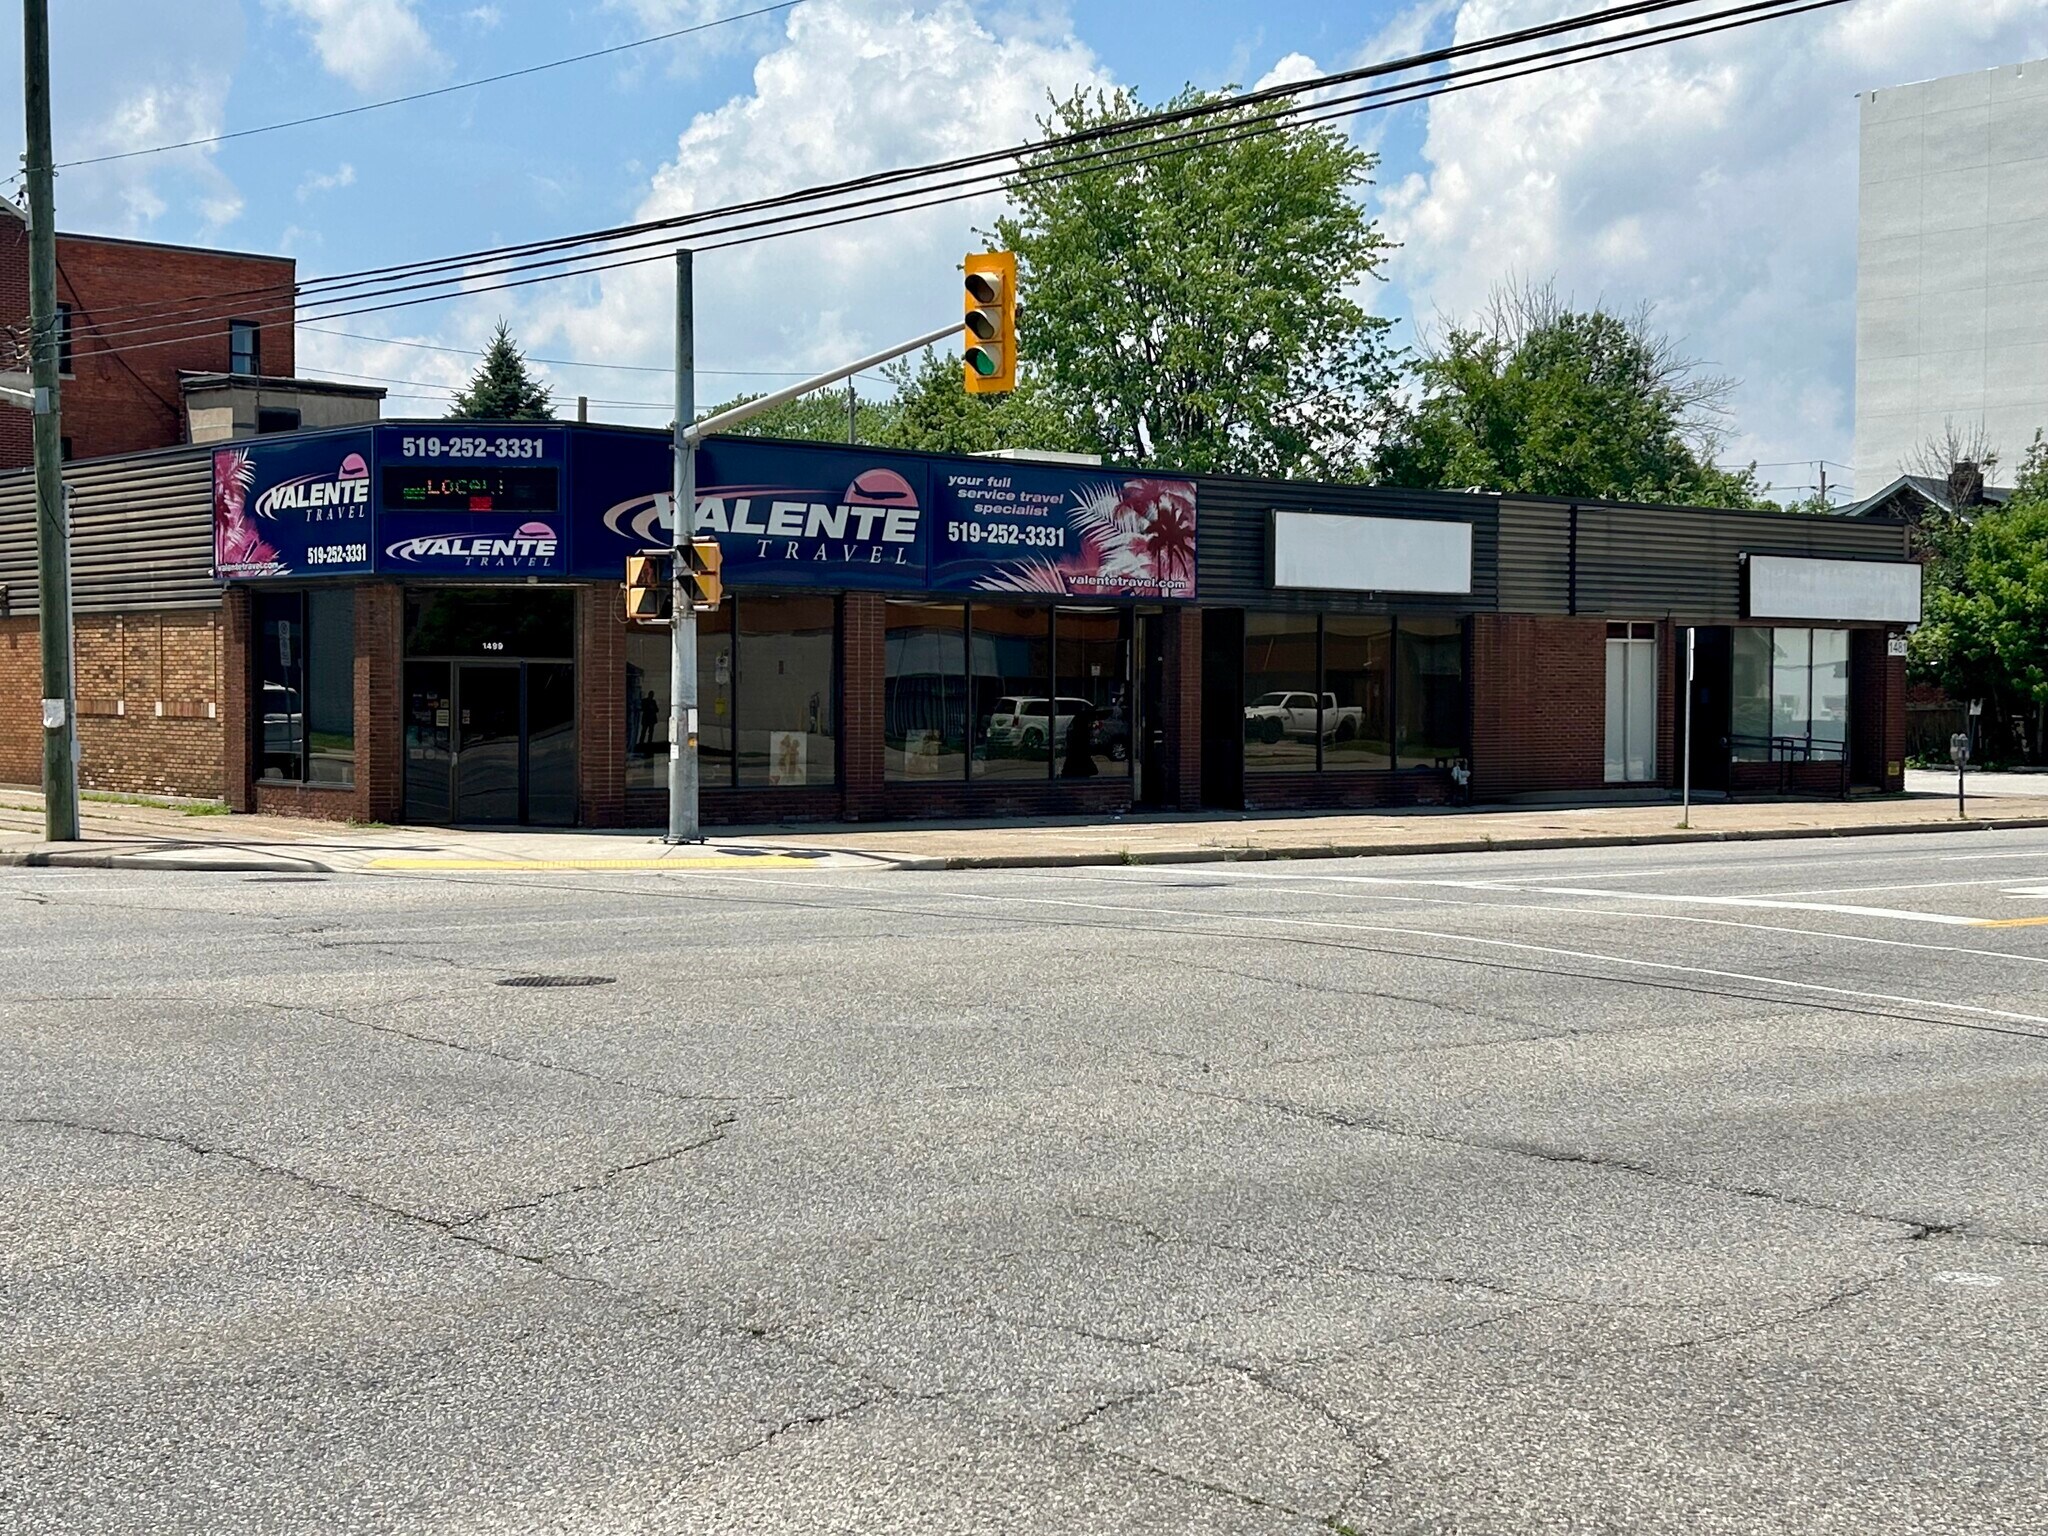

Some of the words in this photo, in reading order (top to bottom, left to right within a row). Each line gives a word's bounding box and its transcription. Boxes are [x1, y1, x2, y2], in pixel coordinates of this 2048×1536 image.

[402, 436, 543, 458] 519-252-3331
[948, 475, 984, 486] your
[987, 477, 1012, 488] full
[271, 479, 370, 510] VALENTE
[957, 489, 1016, 501] service
[1020, 491, 1064, 504] travel
[306, 505, 365, 522] TRAVEL
[973, 503, 1049, 517] specialist
[948, 521, 1065, 547] 519-252-3331
[307, 543, 367, 565] 519-252-3331
[411, 539, 558, 556] VALENTE
[757, 539, 907, 565] TRAVEL
[465, 557, 551, 567] TRAVEL
[1068, 575, 1186, 589] valentetravel.com
[482, 642, 504, 650] 1499
